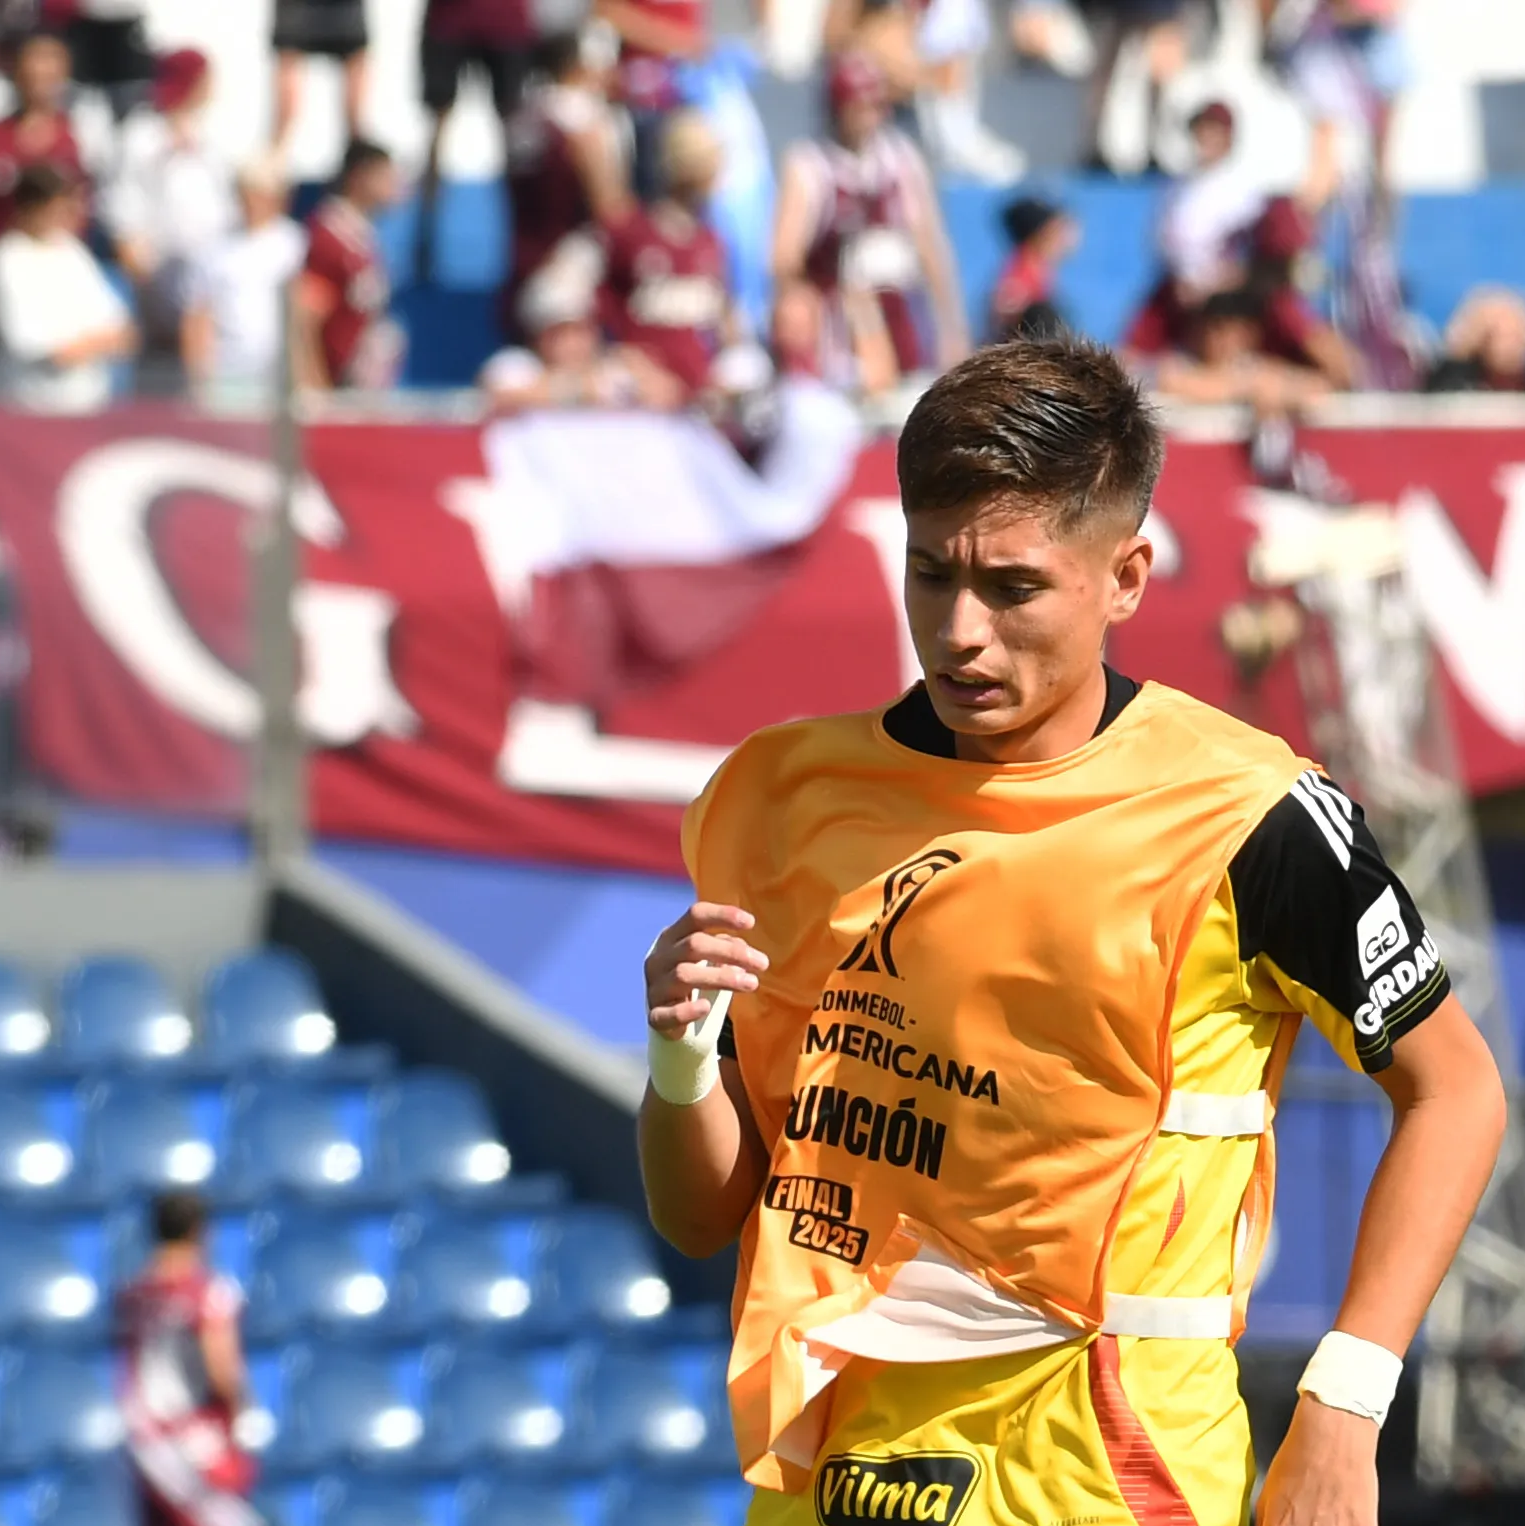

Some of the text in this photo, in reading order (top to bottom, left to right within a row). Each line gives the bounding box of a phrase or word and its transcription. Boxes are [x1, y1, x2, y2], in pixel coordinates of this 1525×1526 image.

[799, 1022, 1000, 1106] MERICANA
[784, 1084, 947, 1181] UNCIÓN
[772, 1178, 844, 1218] FINAL
[793, 1216, 862, 1261] 2025
[823, 1464, 954, 1523] Vilma
